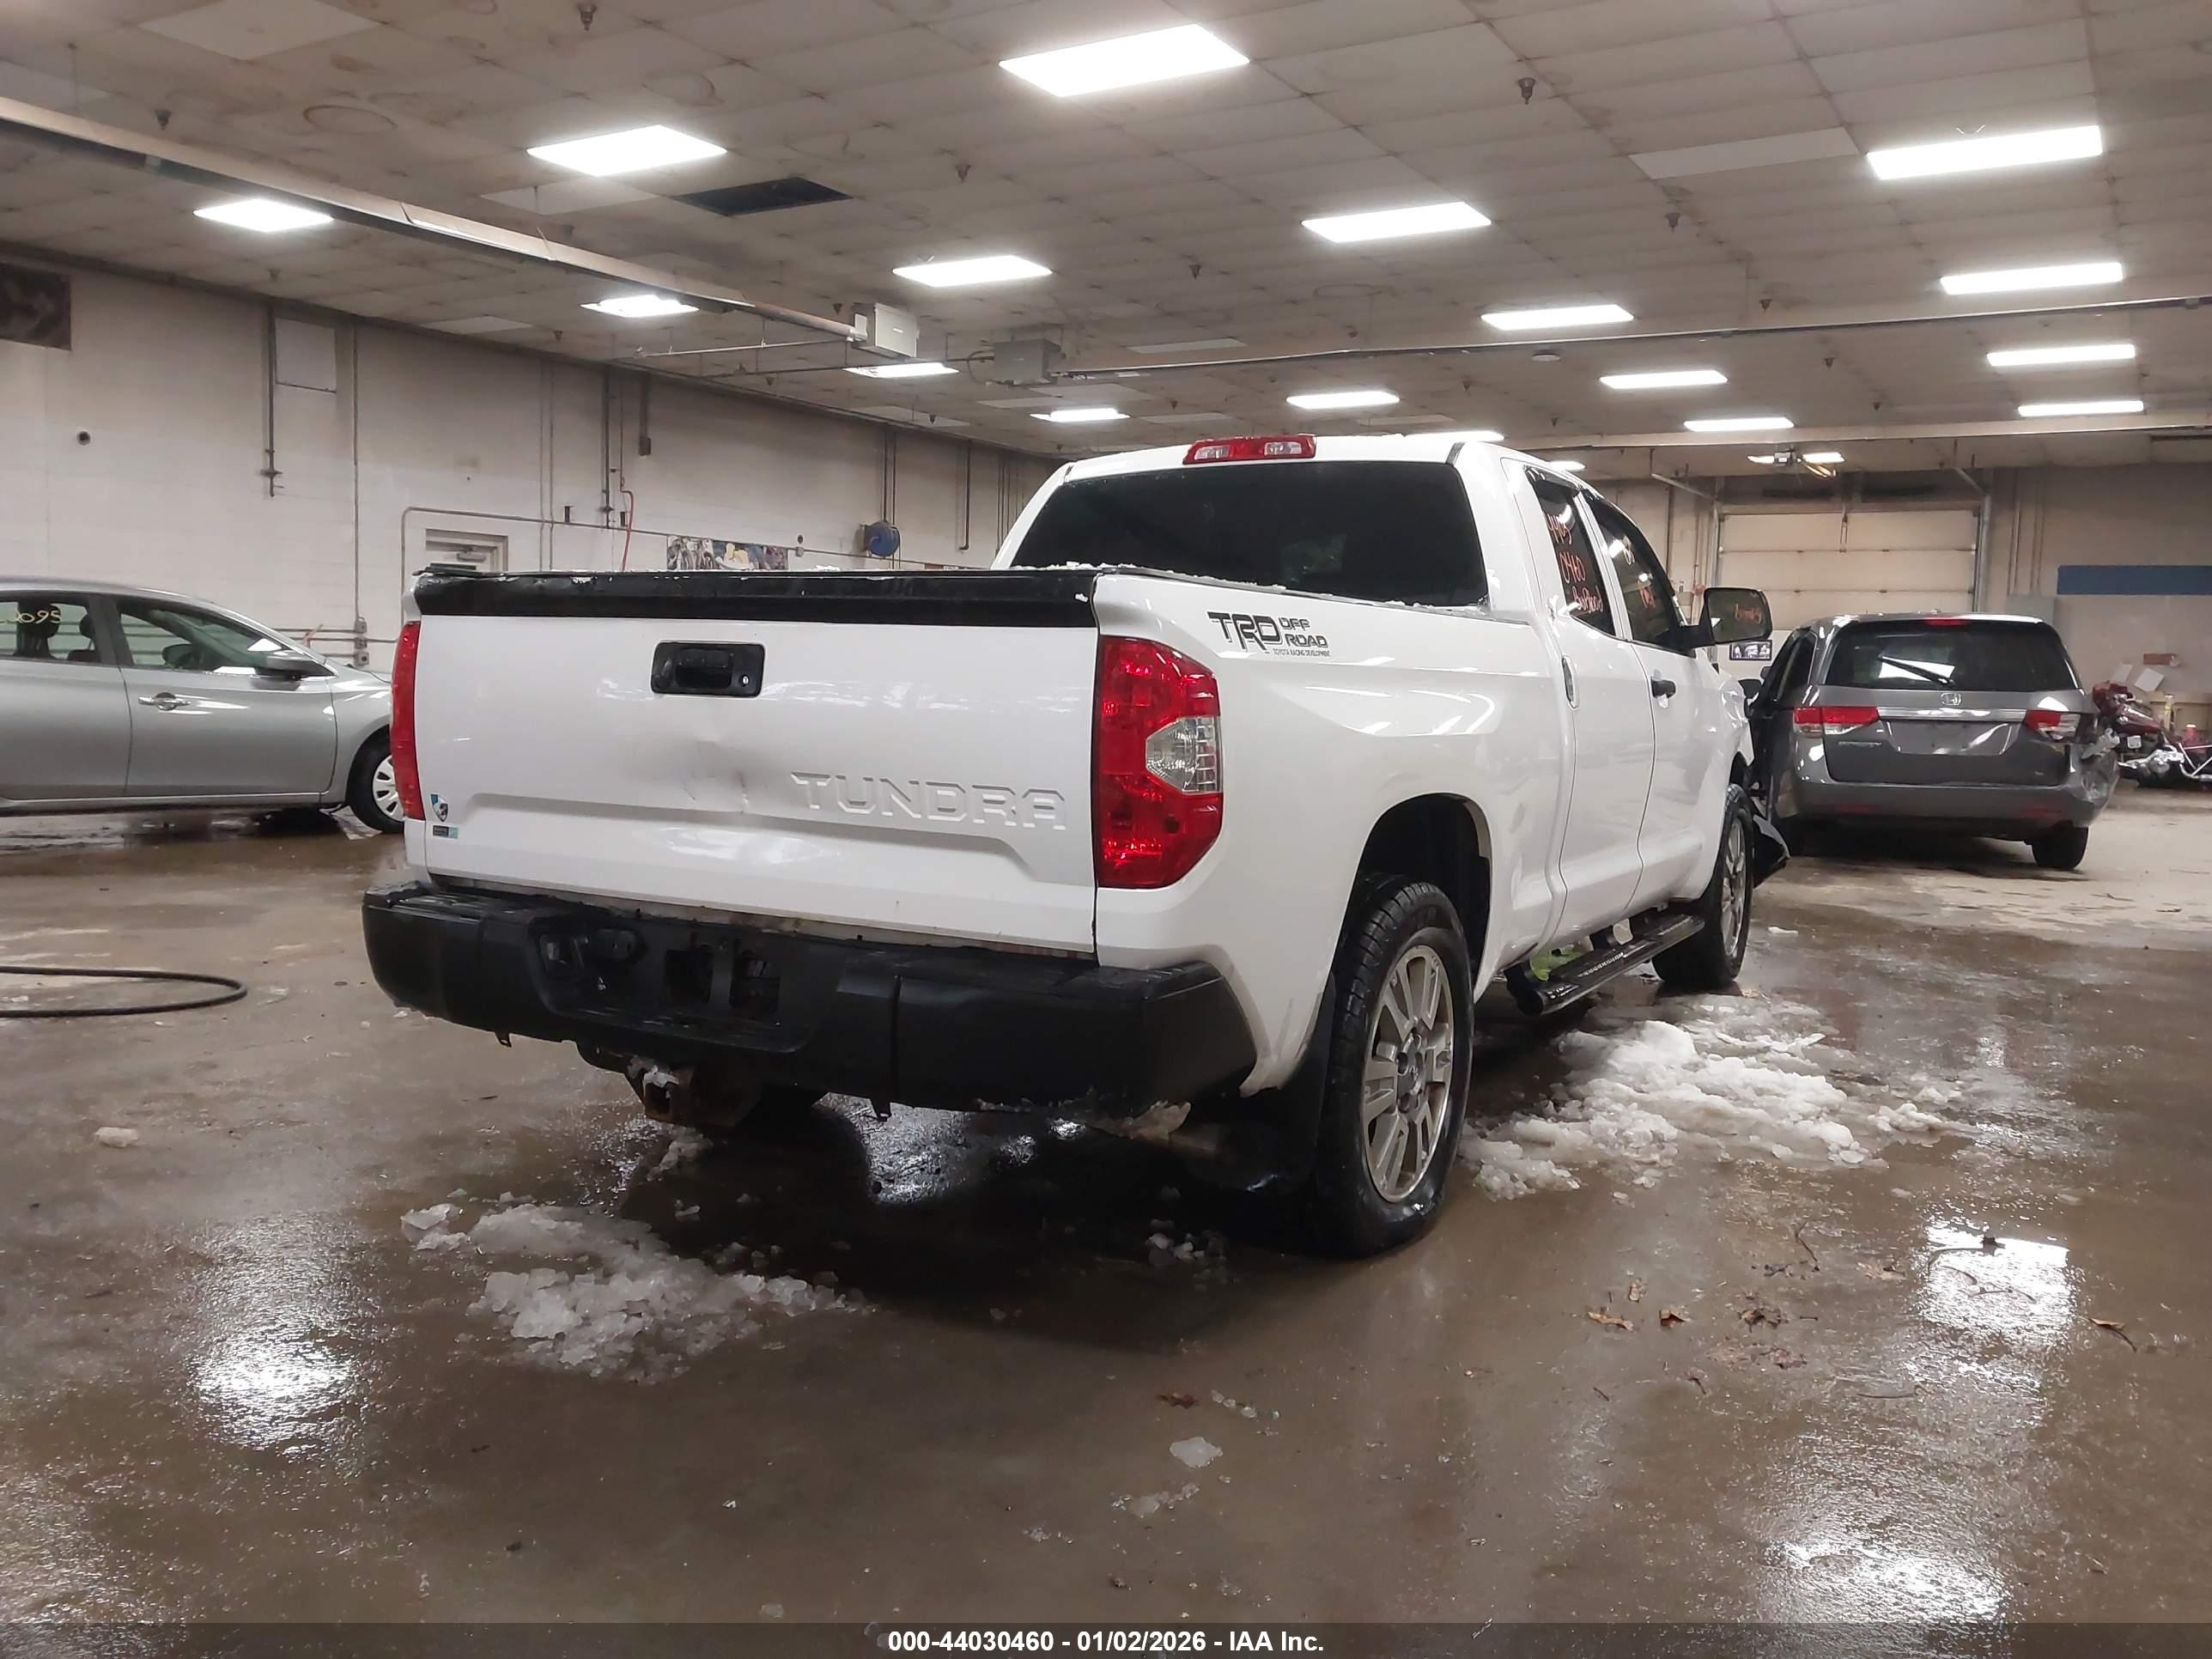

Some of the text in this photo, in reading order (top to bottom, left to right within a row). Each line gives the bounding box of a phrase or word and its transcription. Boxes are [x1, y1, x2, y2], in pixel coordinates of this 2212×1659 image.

[1206, 611, 1283, 653] TRD
[1279, 617, 1310, 631] OFF
[1285, 634, 1328, 647] ROAD
[791, 772, 1066, 830] TUNDRA
